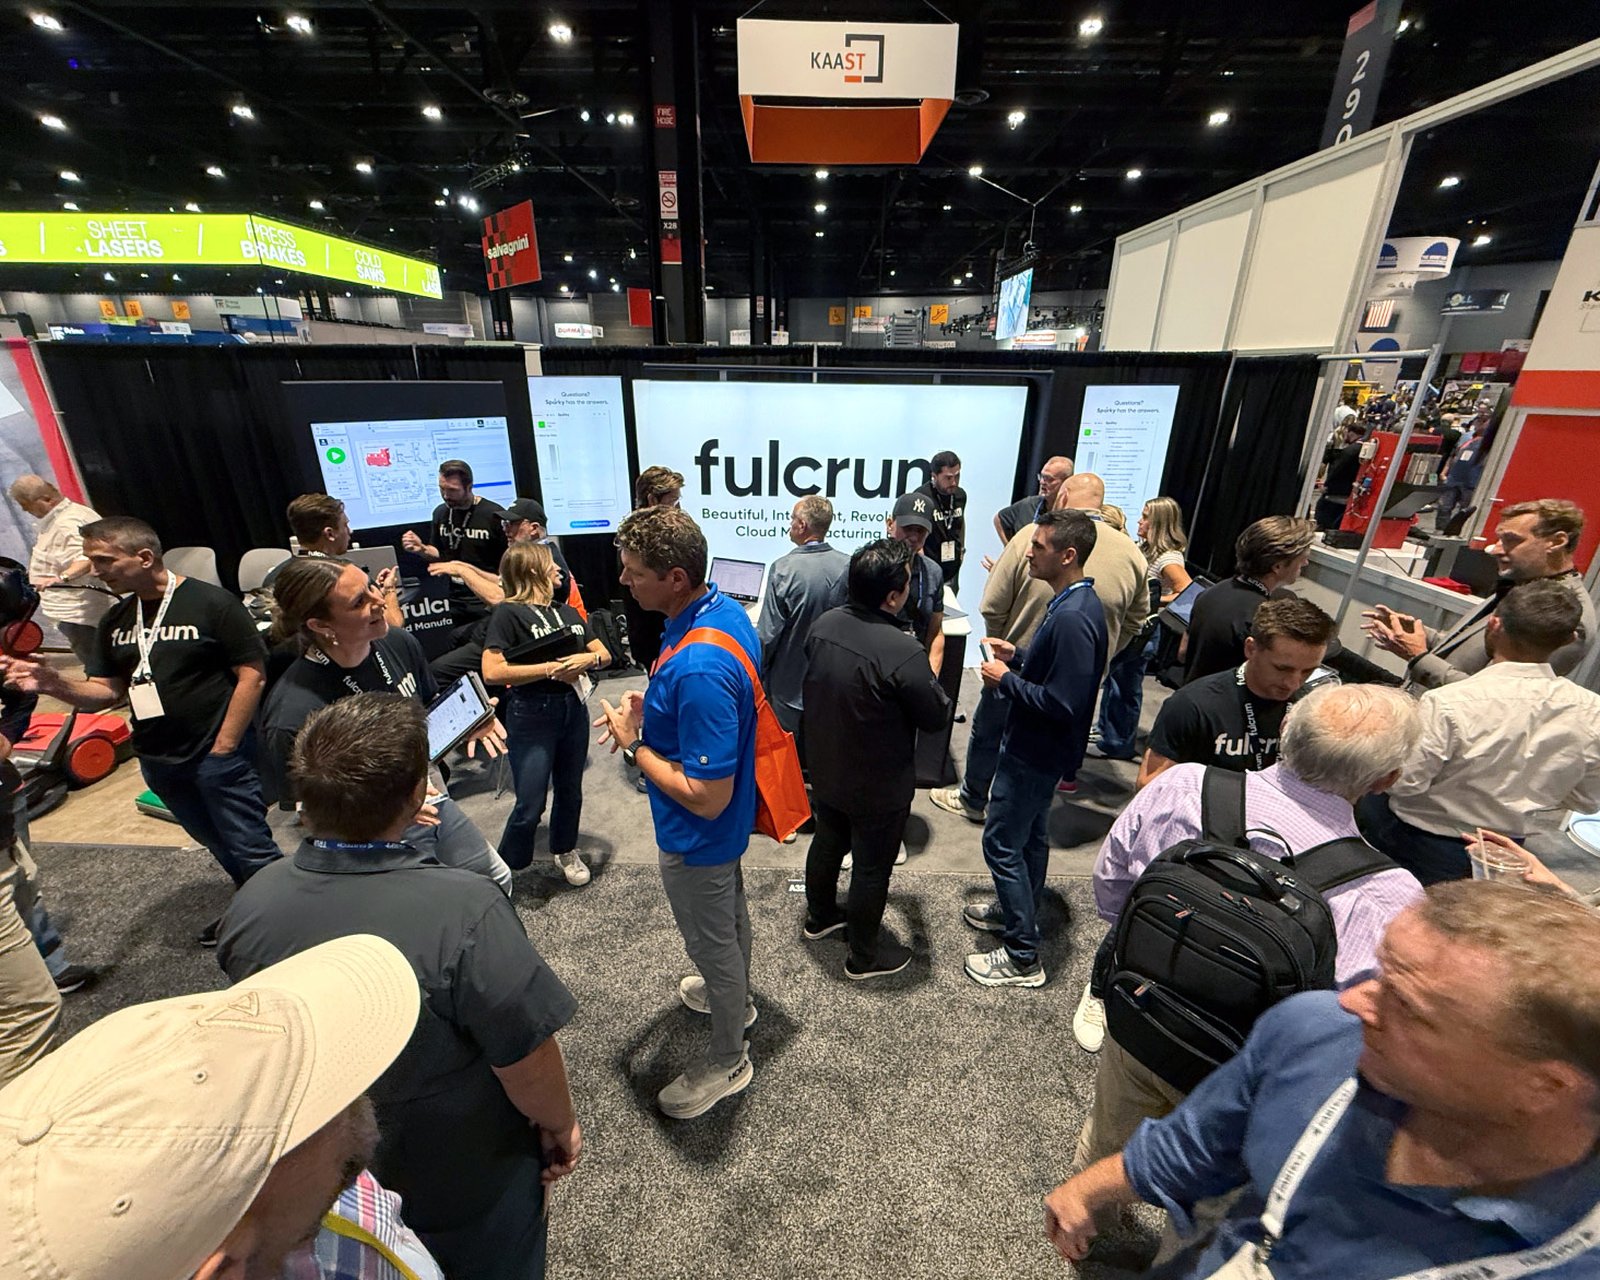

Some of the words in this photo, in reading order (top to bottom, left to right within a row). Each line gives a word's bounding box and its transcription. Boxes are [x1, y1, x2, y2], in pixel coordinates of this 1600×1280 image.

[810, 52, 866, 70] KAAST
[656, 116, 674, 125] HOSE
[657, 108, 672, 116] FIRE
[86, 220, 147, 239] SHEET
[246, 221, 296, 249] PRESS
[84, 239, 164, 257] LASERS
[240, 240, 306, 267] BRAKES
[487, 233, 529, 259] salvagnini
[354, 249, 382, 268] COLD
[356, 265, 386, 283] SAWS
[701, 508, 768, 522] Beautiful,
[735, 525, 776, 537] Cloud
[1245, 702, 1258, 736] fulcrum
[728, 1059, 748, 1082] HOKA
